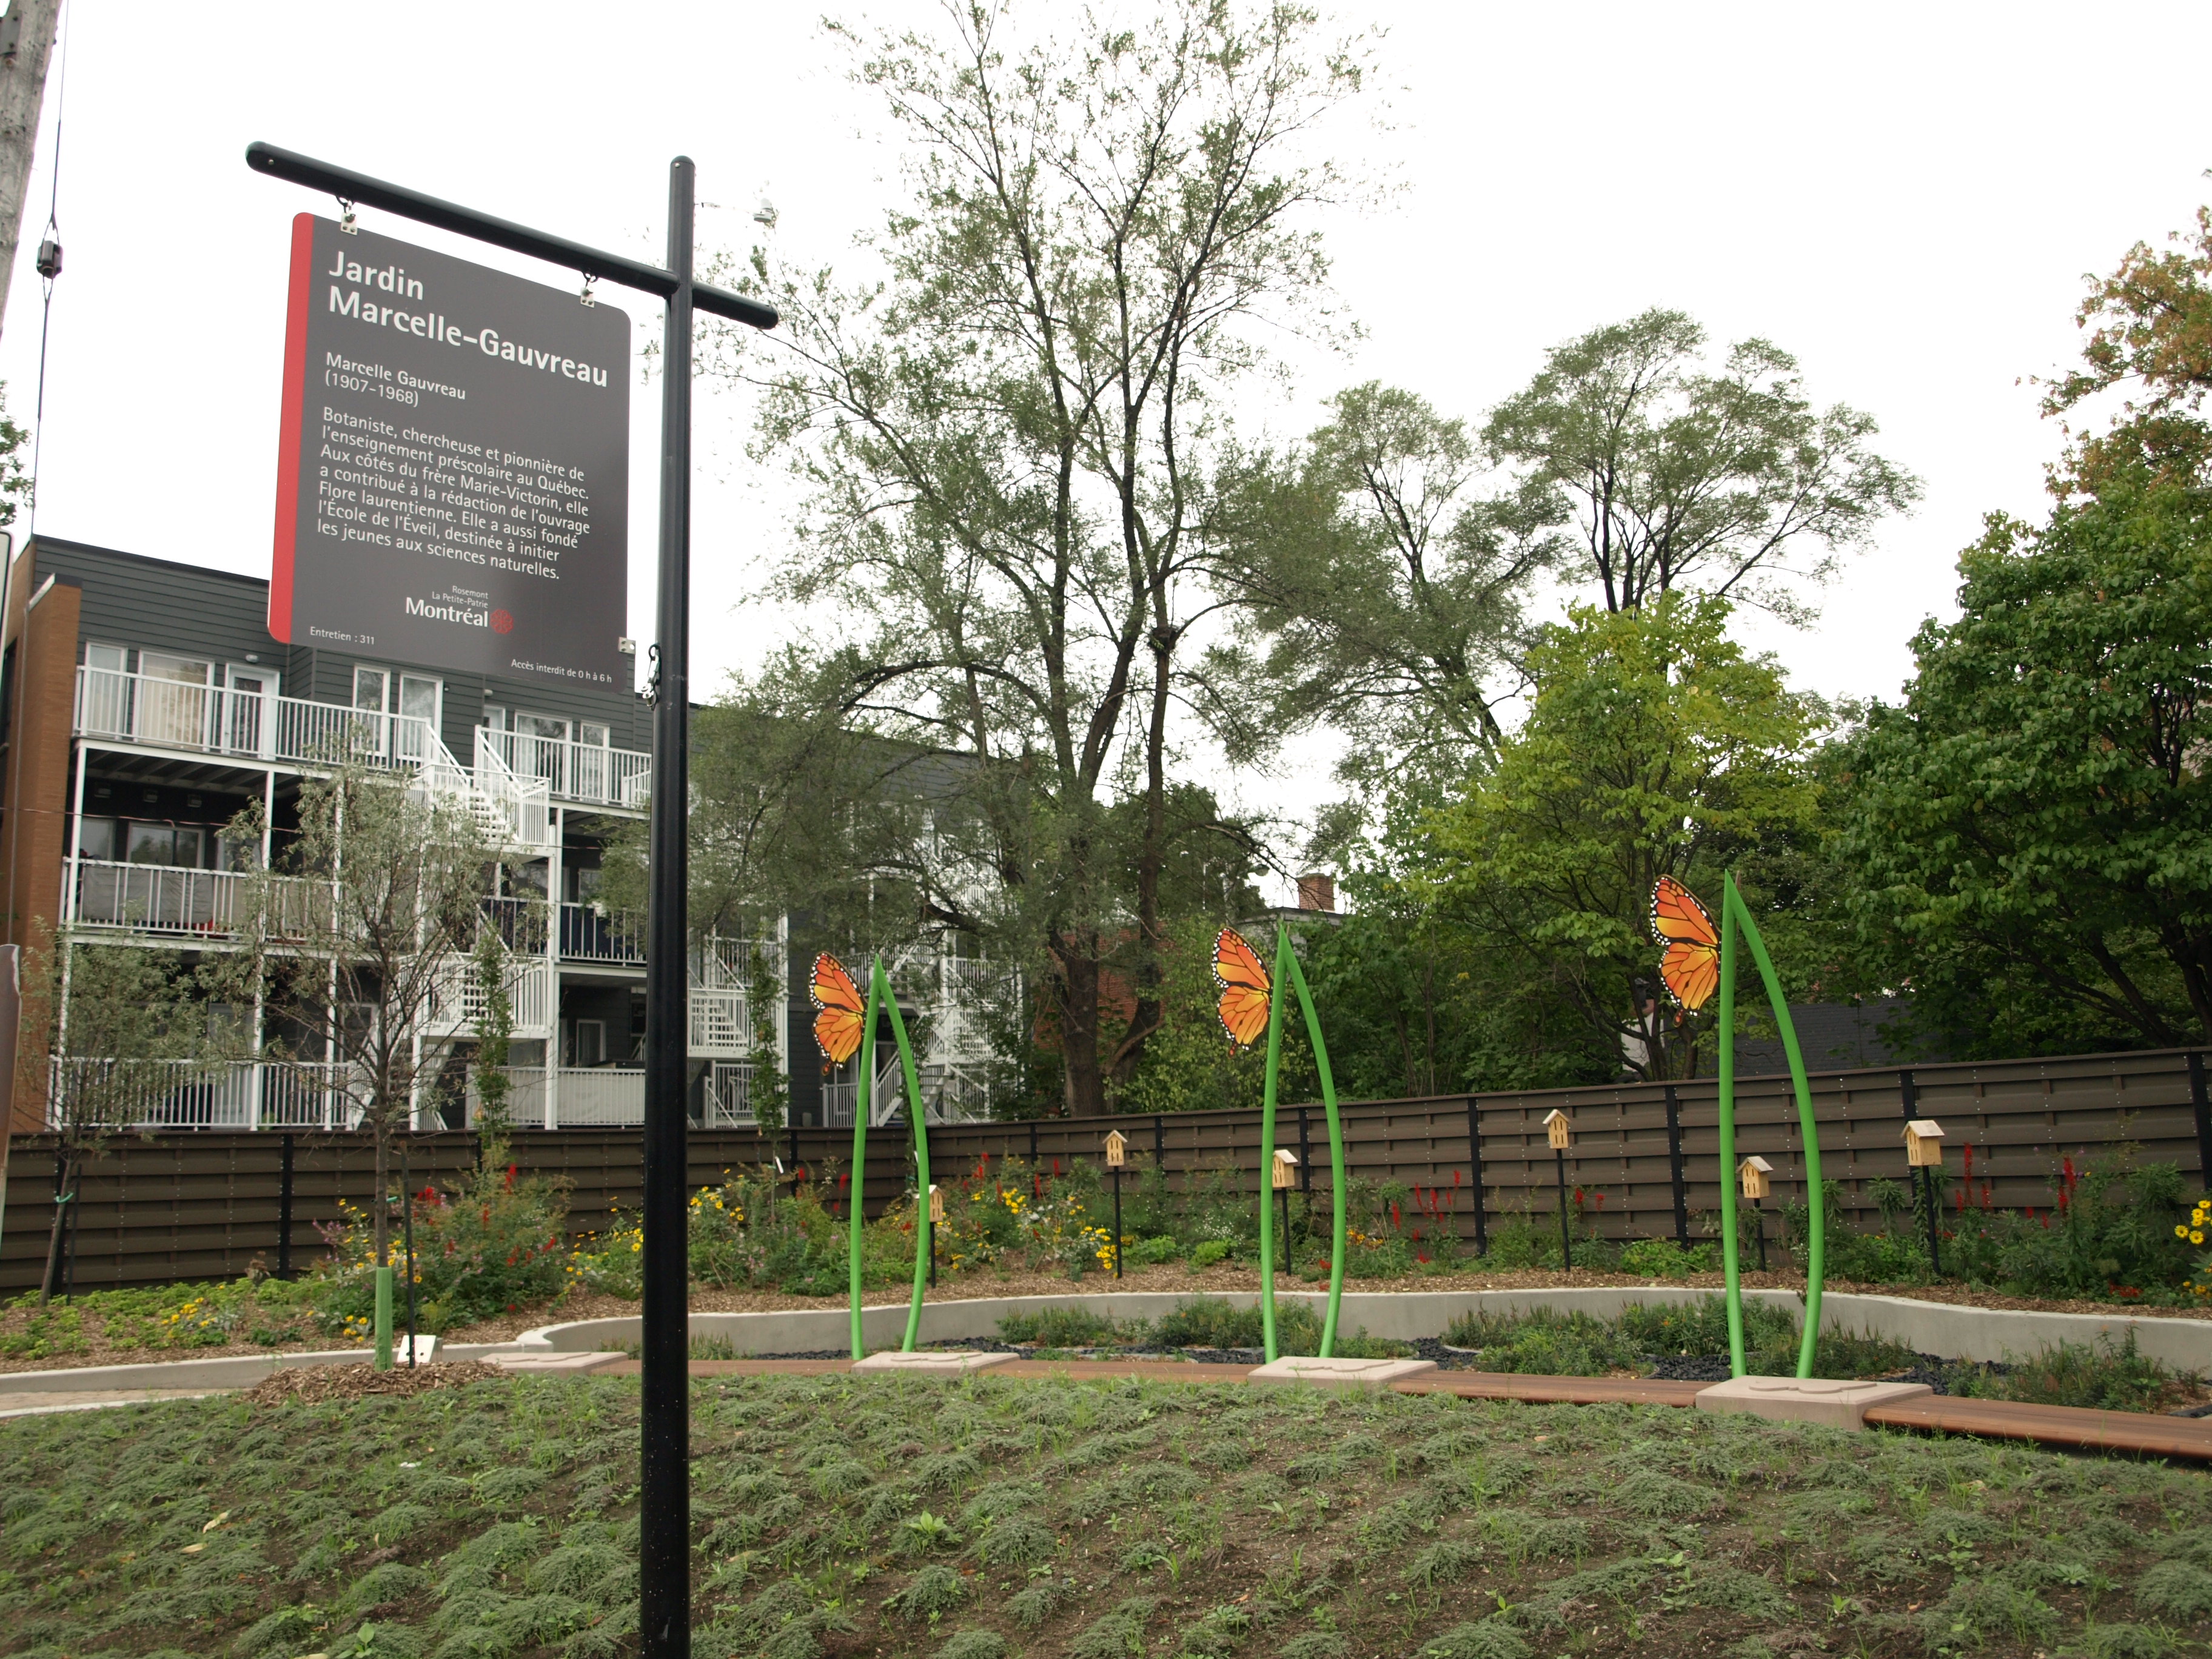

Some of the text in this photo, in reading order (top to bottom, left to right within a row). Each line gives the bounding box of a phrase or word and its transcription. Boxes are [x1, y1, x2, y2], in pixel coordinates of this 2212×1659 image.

[329, 251, 423, 300] Jardin
[329, 285, 607, 387] Marcelle-Gauvreau
[325, 370, 418, 407] (1907-1968)
[326, 352, 466, 400] Marcelle Gauvreau
[323, 406, 585, 481] Botaniste, chercheuse et pionnière de
[323, 425, 589, 500] l'enseignement préscolaire au Québec.
[320, 444, 589, 517] Aux côtés du frère Marie-Victorin, elle
[320, 466, 590, 535] a contribué à la rédaction de l'ouvrage
[319, 498, 560, 561] l'École de l'Éveil, destinée à initier
[320, 480, 578, 549] Flore laurentienne. Elle a aussi fondé
[318, 518, 560, 580] les jeunes aux sciences naturelles.
[406, 597, 488, 628] Montréal
[432, 591, 488, 609] La Petite-Patrie
[452, 585, 489, 599] Rosemont
[310, 626, 351, 641] Entretien
[360, 634, 374, 645] 311
[511, 659, 612, 683] Accès interdit de 0 h à 6 h
